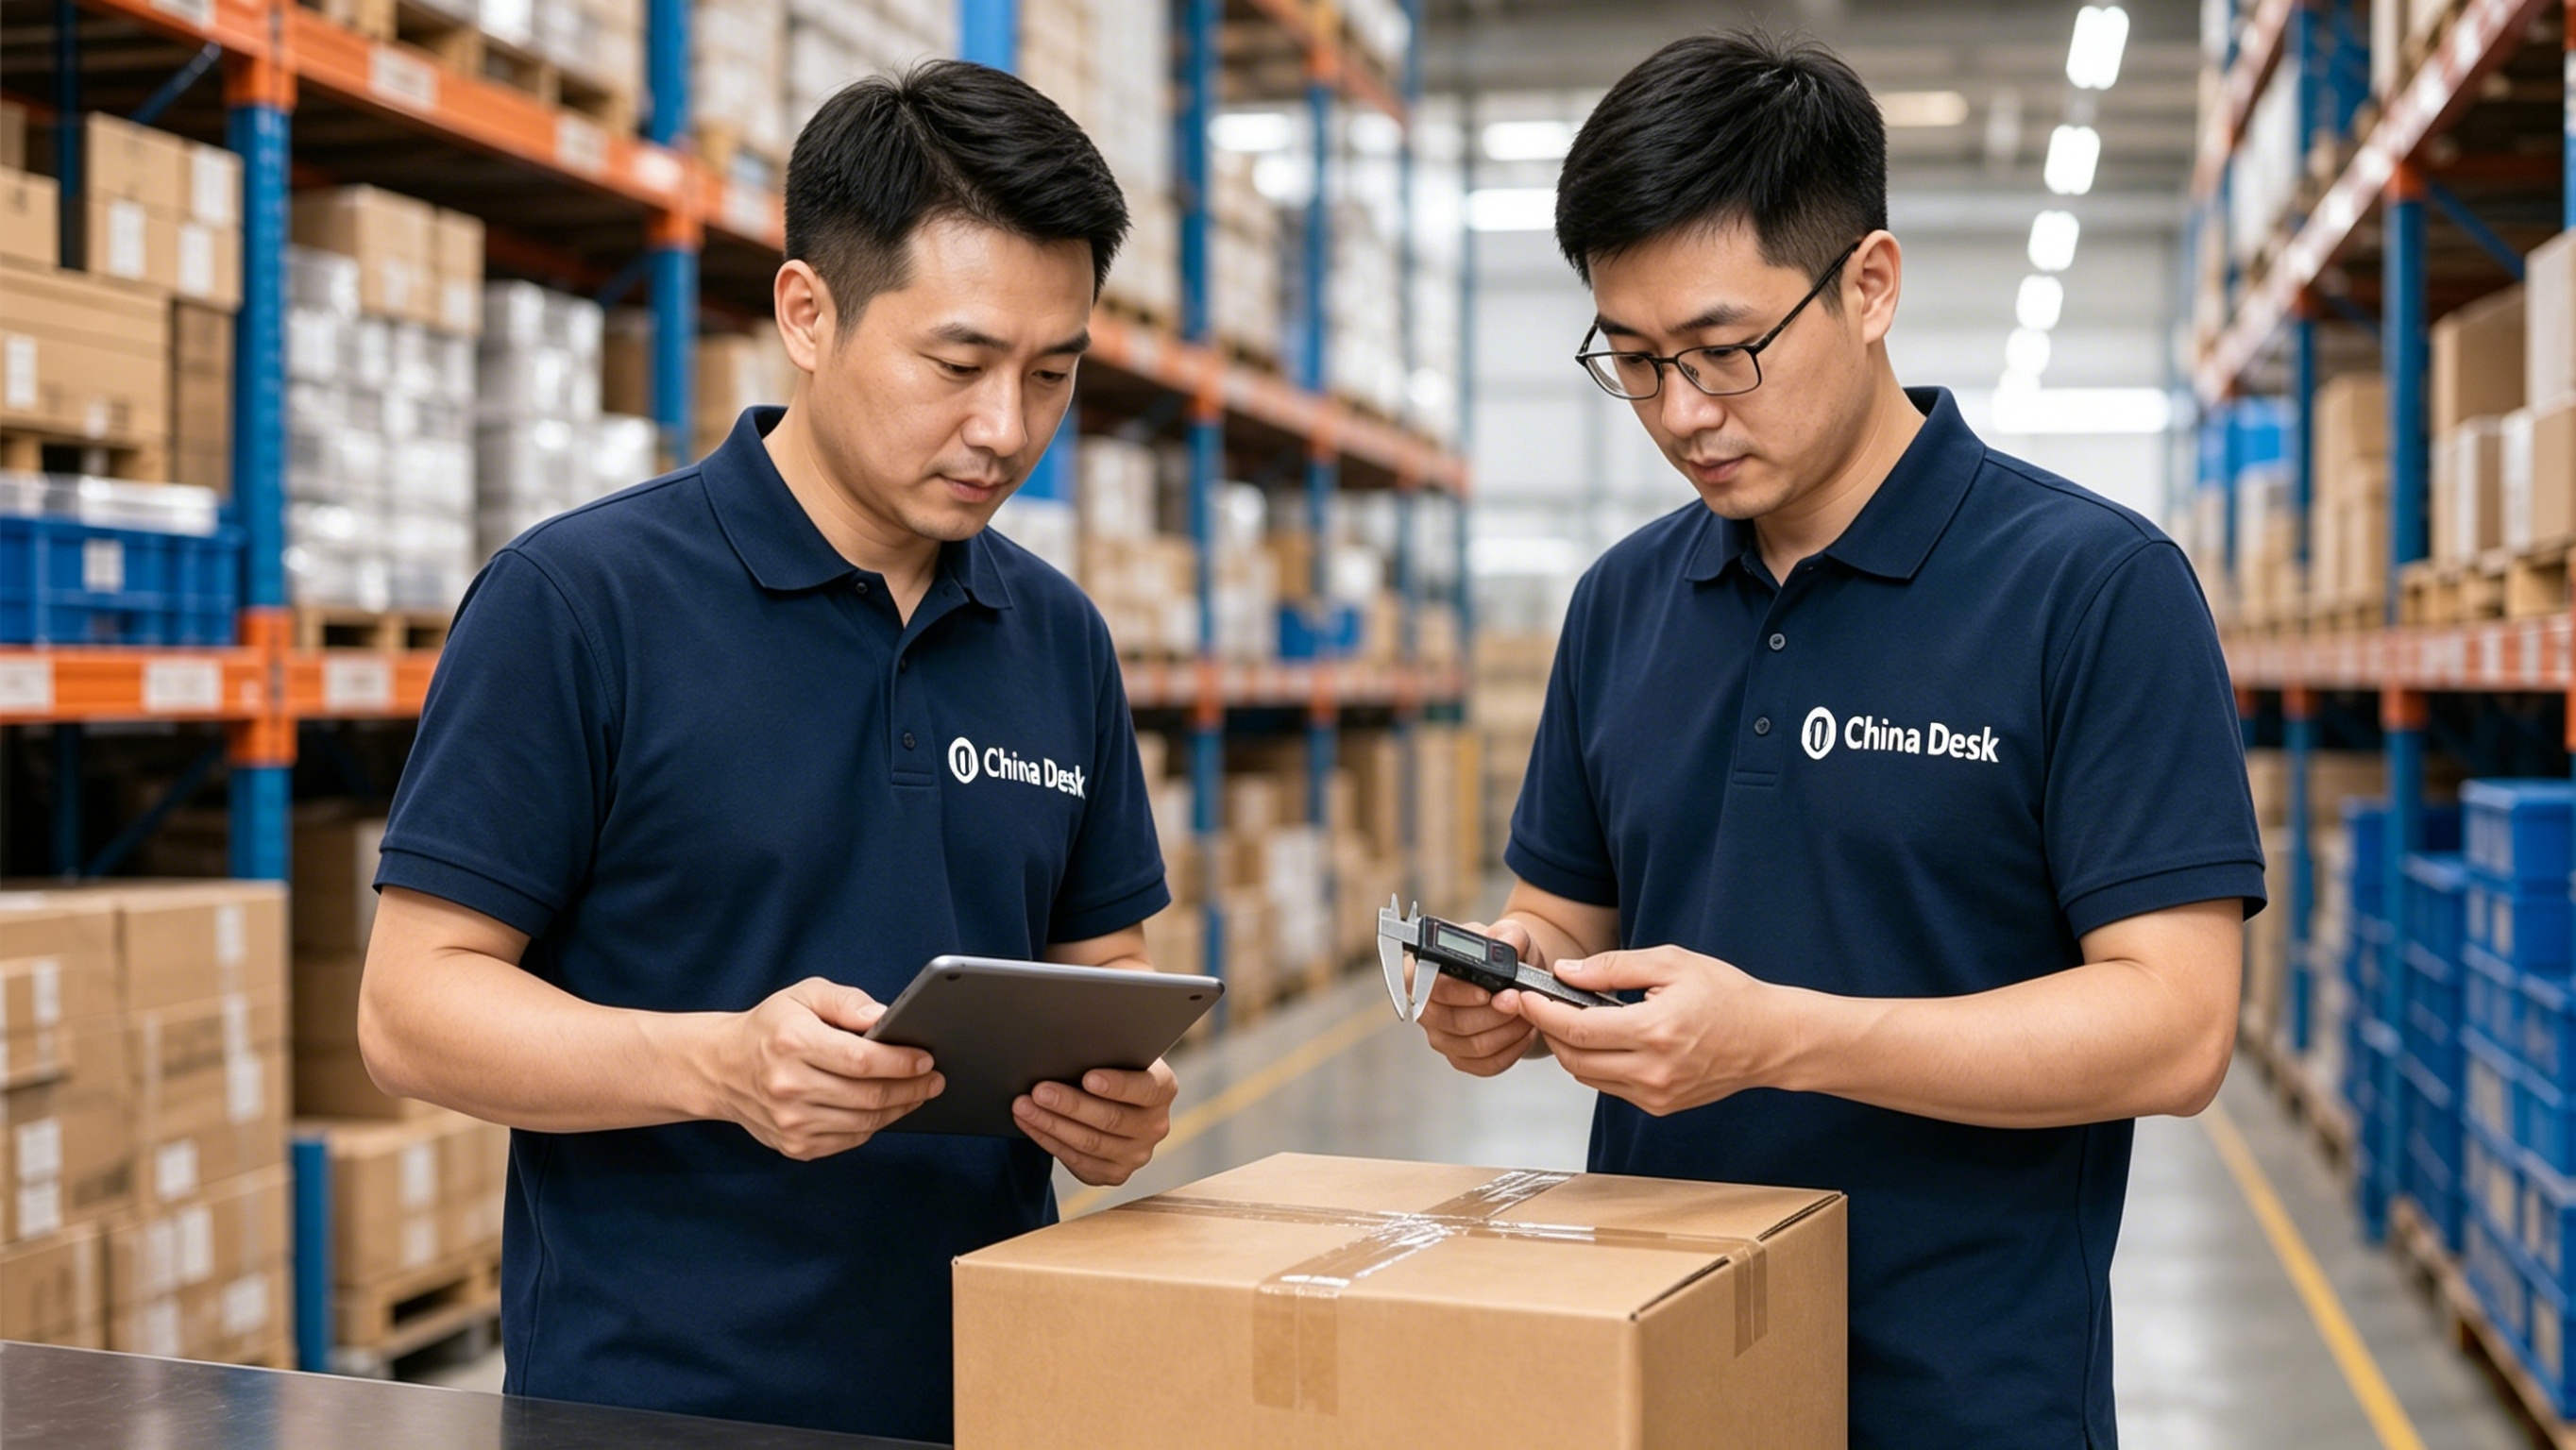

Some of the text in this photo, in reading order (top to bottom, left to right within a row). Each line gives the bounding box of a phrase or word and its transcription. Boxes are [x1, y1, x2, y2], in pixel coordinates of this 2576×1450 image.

[1844, 716, 2000, 763] China Desk
[983, 747, 1086, 799] China Desk
